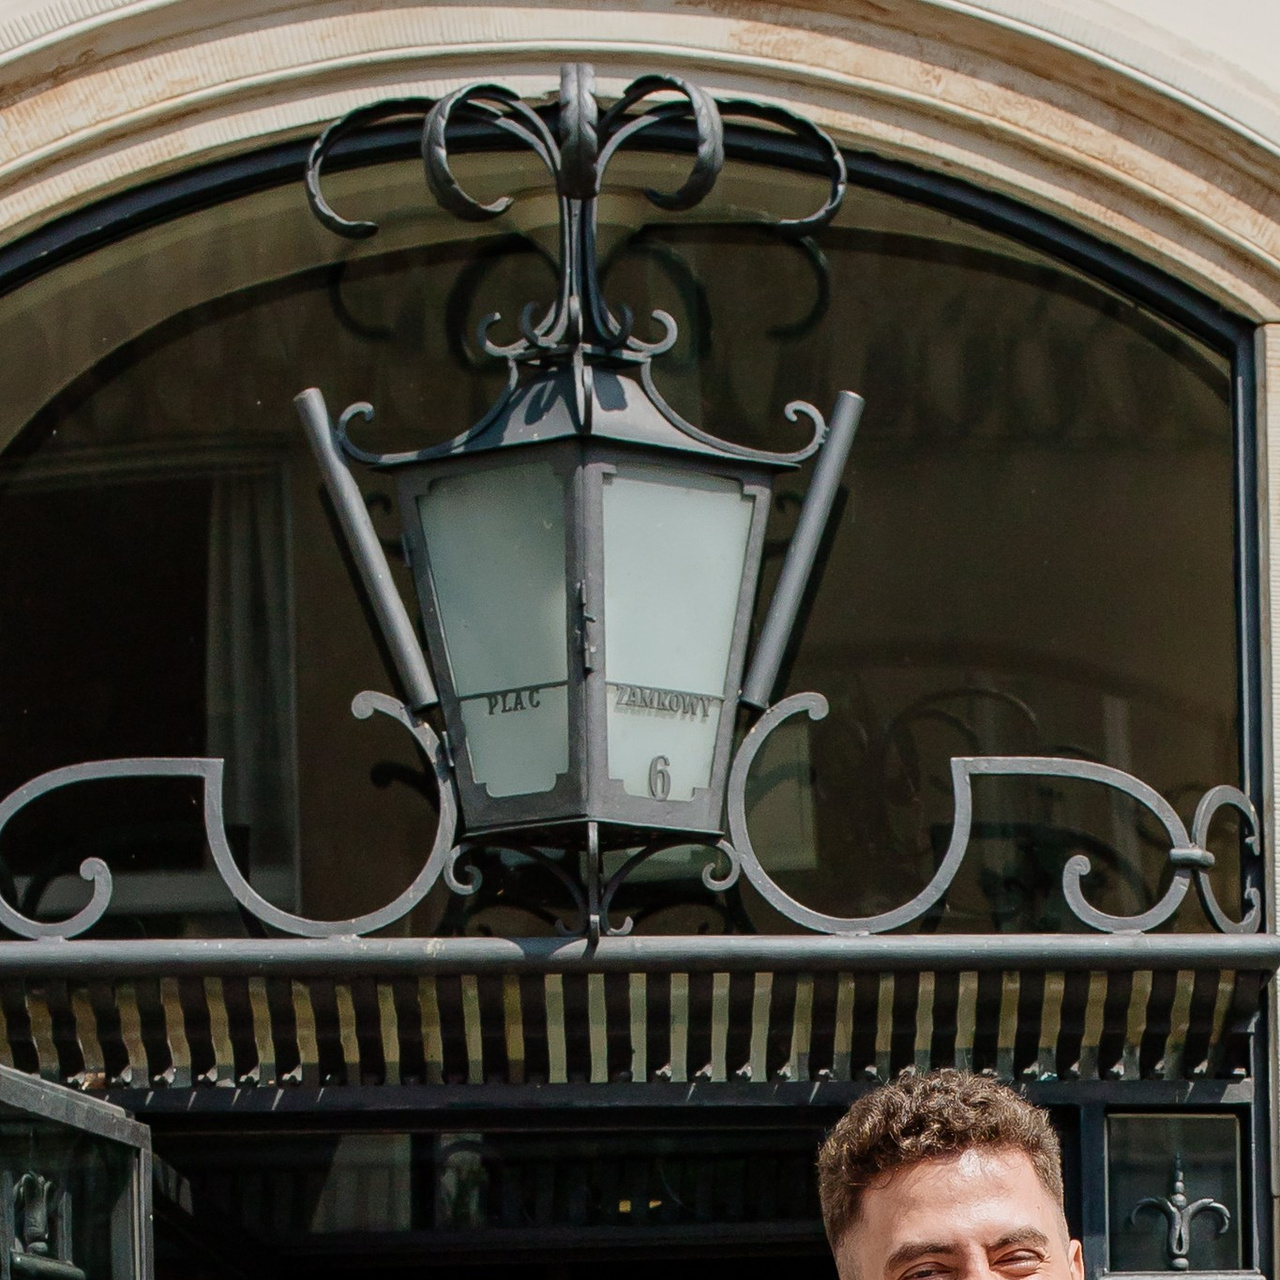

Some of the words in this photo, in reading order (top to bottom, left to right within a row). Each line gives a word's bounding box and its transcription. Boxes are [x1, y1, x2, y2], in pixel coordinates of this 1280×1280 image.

[487, 689, 541, 716] PLAC
[615, 685, 713, 718] ZAMKOWY
[648, 755, 671, 801] 6
